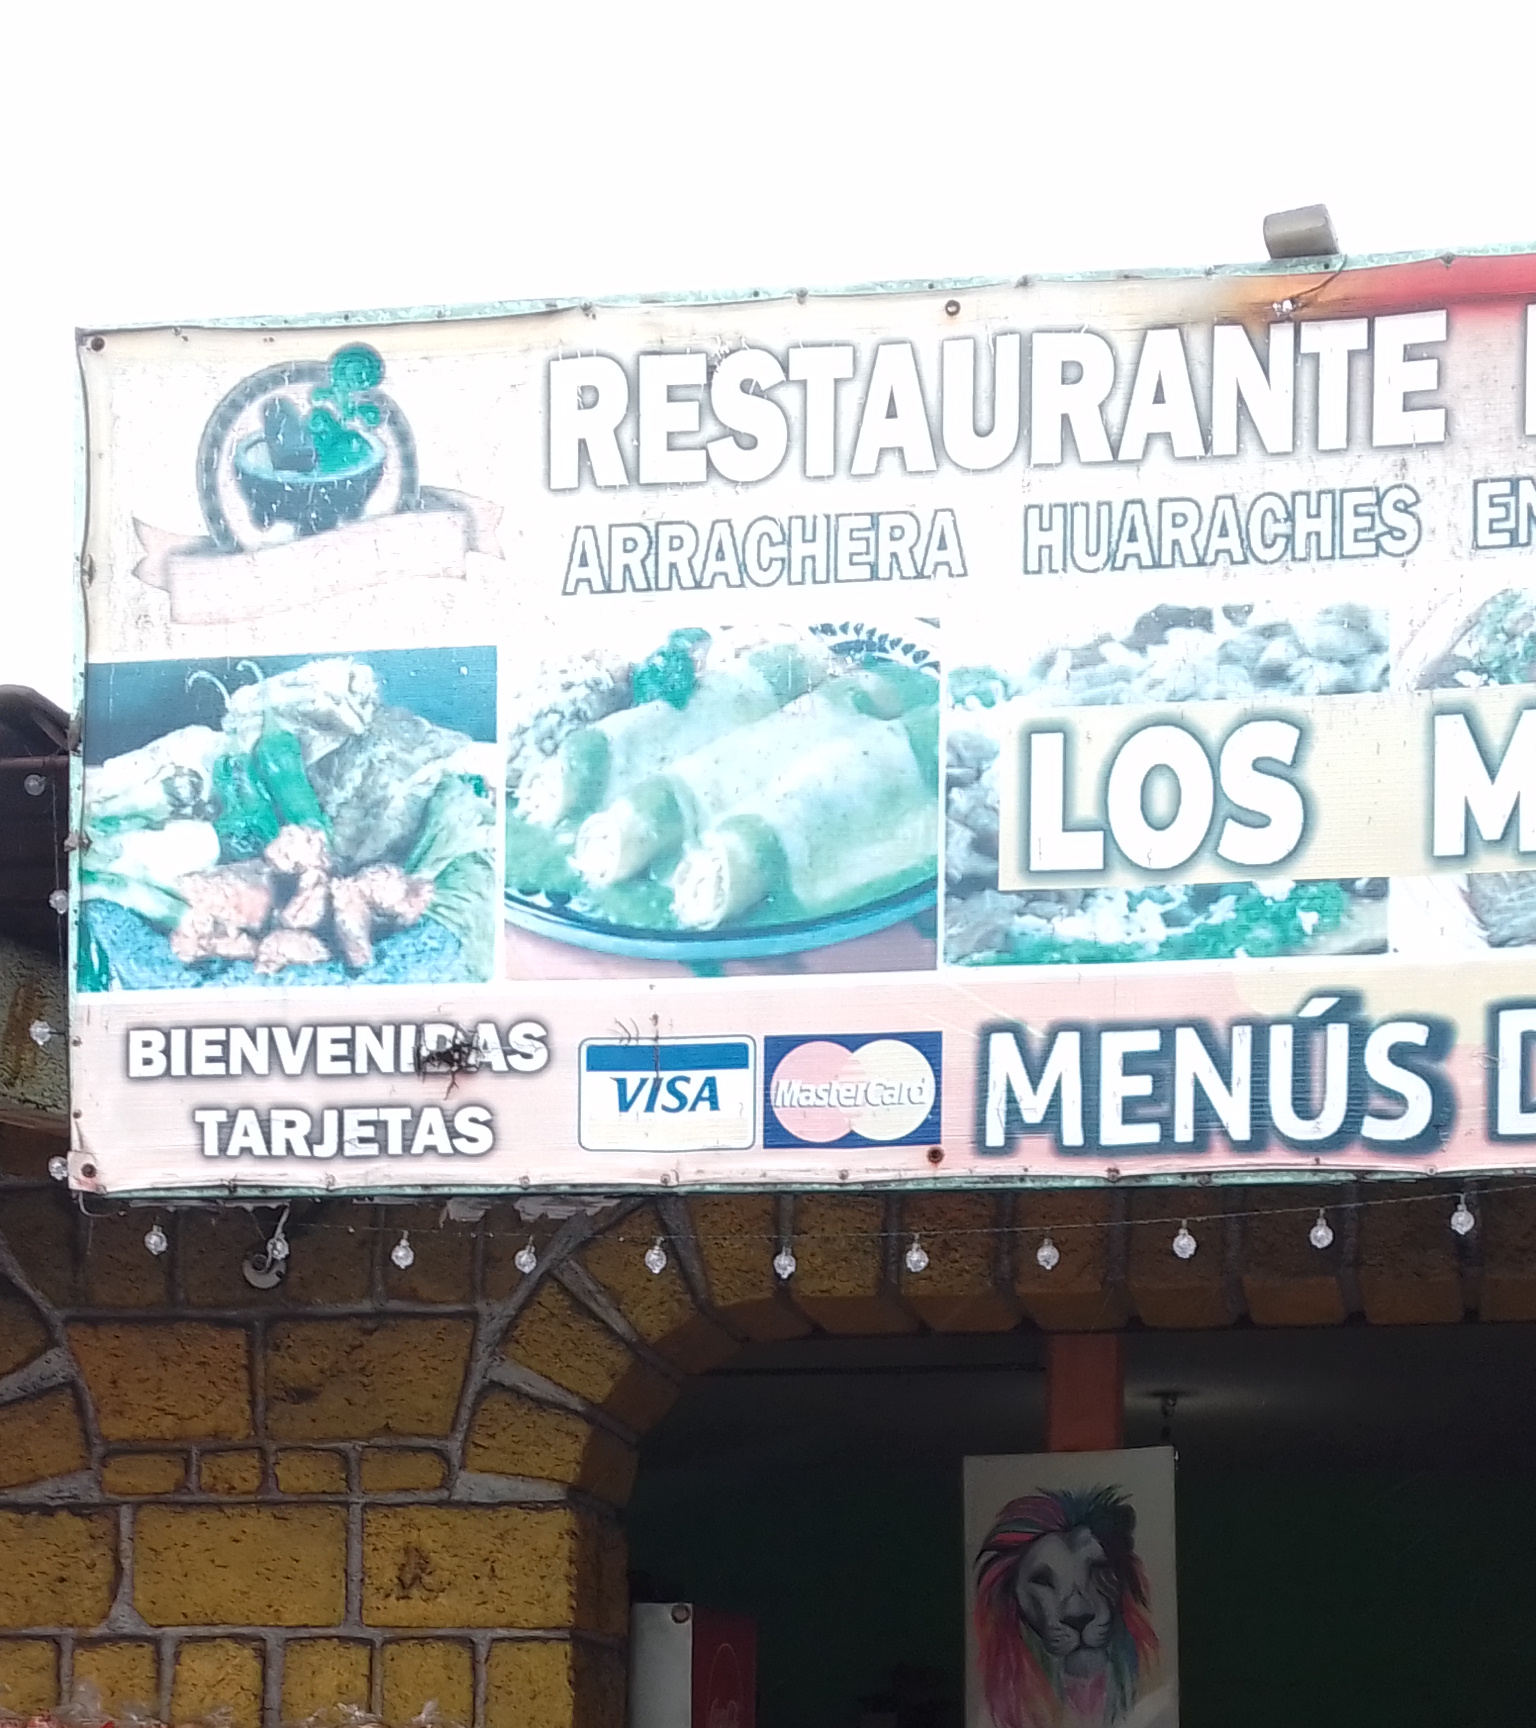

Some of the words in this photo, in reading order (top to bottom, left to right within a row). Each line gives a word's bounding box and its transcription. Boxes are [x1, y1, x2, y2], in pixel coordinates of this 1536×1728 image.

[548, 309, 1450, 493] RESTAURANTE
[560, 508, 968, 597] ARRACHERA
[1023, 483, 1424, 576] HUARACHES
[1024, 718, 1308, 877] LOS
[127, 1020, 550, 1079] BIENVENIDAS
[982, 994, 1444, 1151] MENÚS
[194, 1106, 495, 1160] TARJETAS
[610, 1075, 721, 1114] VISA
[774, 1077, 932, 1109] MasterCard
